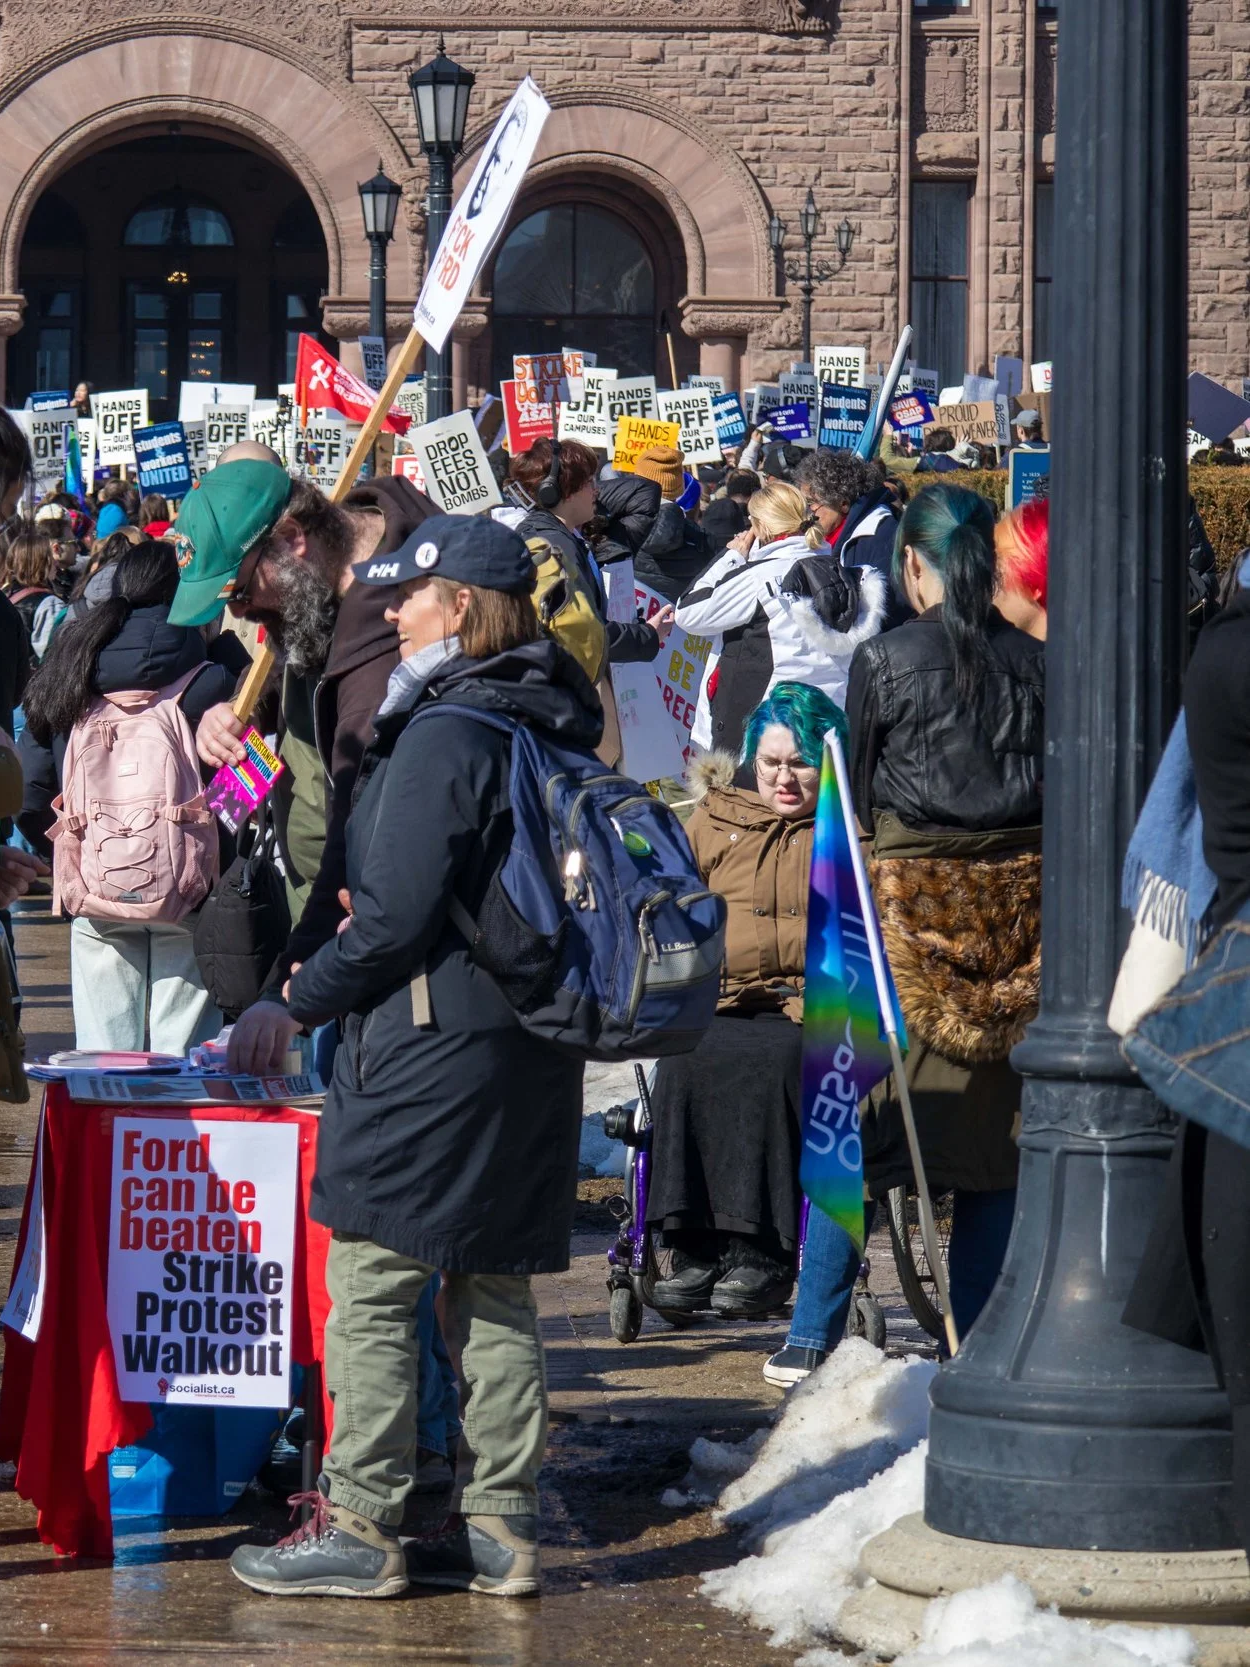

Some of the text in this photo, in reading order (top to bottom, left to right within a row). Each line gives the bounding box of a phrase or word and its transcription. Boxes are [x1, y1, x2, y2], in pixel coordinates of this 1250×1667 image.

[362, 343, 383, 353] HANDS
[365, 355, 384, 370] OFF
[515, 353, 583, 380] STRIKE
[819, 356, 860, 367] HANDS
[819, 368, 859, 387] OFF
[913, 376, 936, 387] HANDS
[398, 392, 423, 403] DROP
[608, 388, 652, 401] HANDS
[783, 383, 815, 395] HANDS
[102, 400, 141, 412] HANDS
[609, 400, 652, 422] OFF
[665, 398, 708, 411] HANDS
[824, 396, 867, 409] students
[892, 397, 917, 410] SAVE
[208, 412, 247, 423] HANDS
[411, 412, 427, 423] OT
[578, 415, 595, 423] OUR
[667, 409, 709, 429] OFF
[840, 408, 849, 419] &
[895, 406, 923, 420] OSAP
[938, 403, 979, 424] PROUD
[103, 413, 141, 434] OFF
[253, 417, 278, 431] HAN
[564, 423, 607, 435] CAMPUSES
[627, 421, 670, 441] HANDS
[824, 418, 864, 432] workers
[961, 420, 998, 440] WEAVER
[113, 435, 129, 443] OUR
[208, 424, 246, 443] OFF
[255, 430, 278, 447] OF
[295, 428, 341, 441] HANDS
[682, 429, 700, 437] OUR
[820, 429, 859, 448] UNITE
[1185, 432, 1207, 445] SAP
[34, 435, 63, 458] OF
[103, 445, 134, 453] CAMPUS
[135, 432, 182, 453] students
[425, 432, 468, 461] DROP
[626, 440, 646, 451] OFF
[140, 452, 185, 472] workers
[431, 448, 477, 479] FEES
[140, 465, 188, 488] UNITED
[191, 467, 207, 479] AP
[437, 466, 481, 498] NOT
[444, 485, 489, 511] BOMBS
[367, 562, 400, 578] HH
[668, 650, 695, 691] BE
[663, 685, 697, 731] REE
[248, 731, 276, 768] RESISTANCE
[244, 741, 273, 781] REVOLUTION
[121, 1130, 211, 1173] Ford
[120, 1173, 256, 1215] can be
[119, 1210, 262, 1254] beaten
[163, 1251, 283, 1295] Strike
[135, 1291, 284, 1337] Protest
[122, 1334, 283, 1377] Walkout
[169, 1383, 235, 1395] socialist.ca
